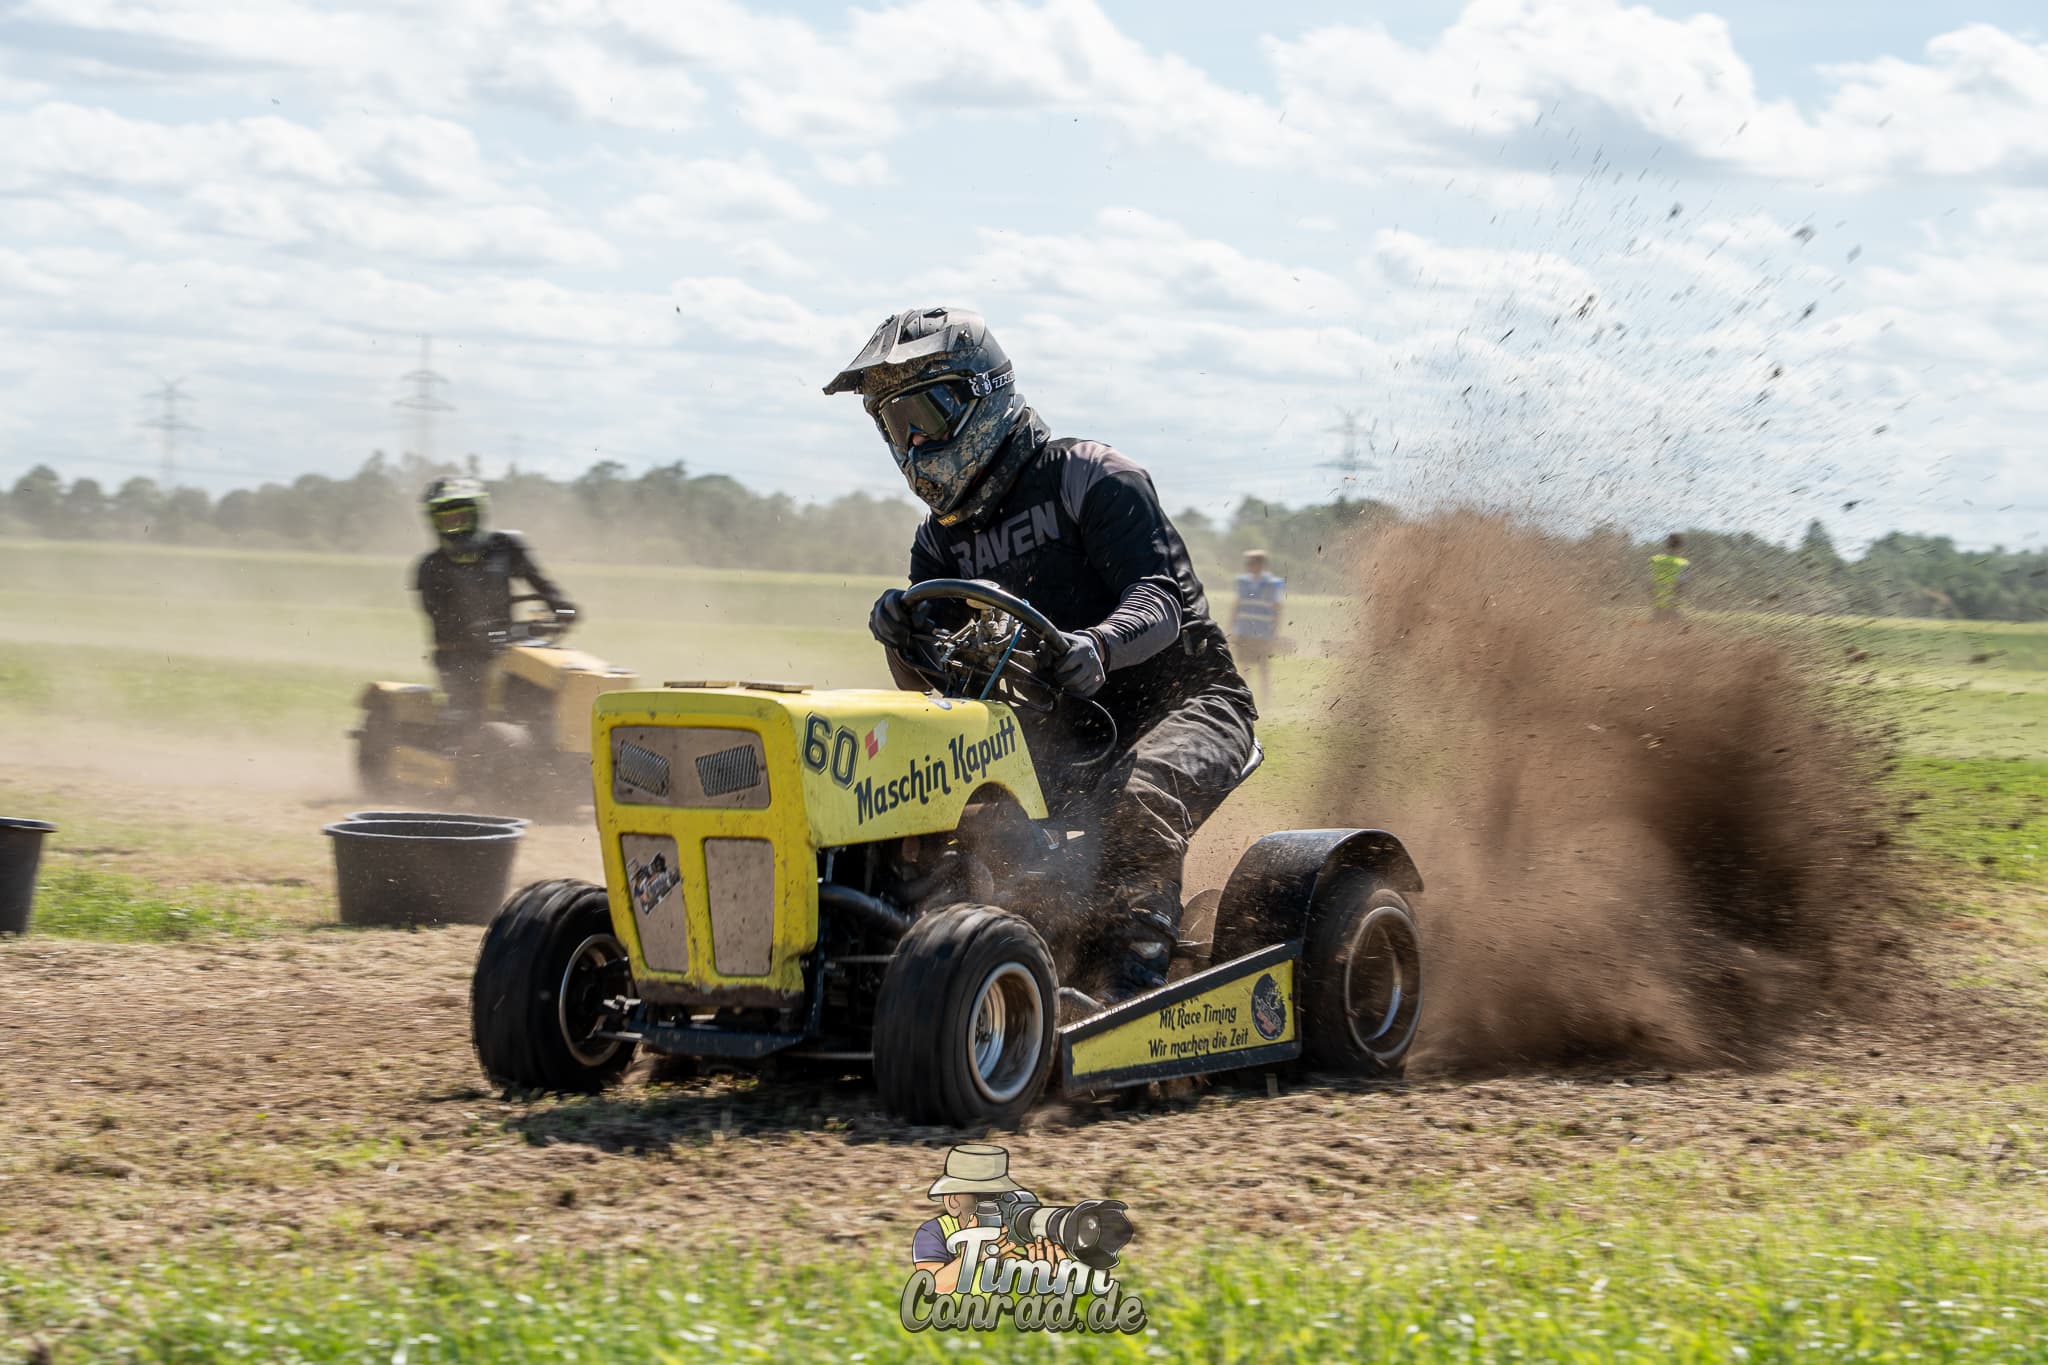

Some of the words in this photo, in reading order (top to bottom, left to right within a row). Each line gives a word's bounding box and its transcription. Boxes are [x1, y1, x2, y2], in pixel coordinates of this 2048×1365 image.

[950, 500, 1059, 579] RAVEN
[802, 711, 859, 789] 60
[854, 755, 951, 825] Maschin
[949, 716, 1016, 783] Kaputt
[1148, 1038, 1167, 1058] Wir
[1170, 1033, 1211, 1058] machen
[1212, 1031, 1227, 1049] die
[1230, 1028, 1249, 1047] Zeit
[1160, 1007, 1175, 1030] MK
[1177, 1007, 1201, 1029] Race
[1203, 1004, 1237, 1024] Timing
